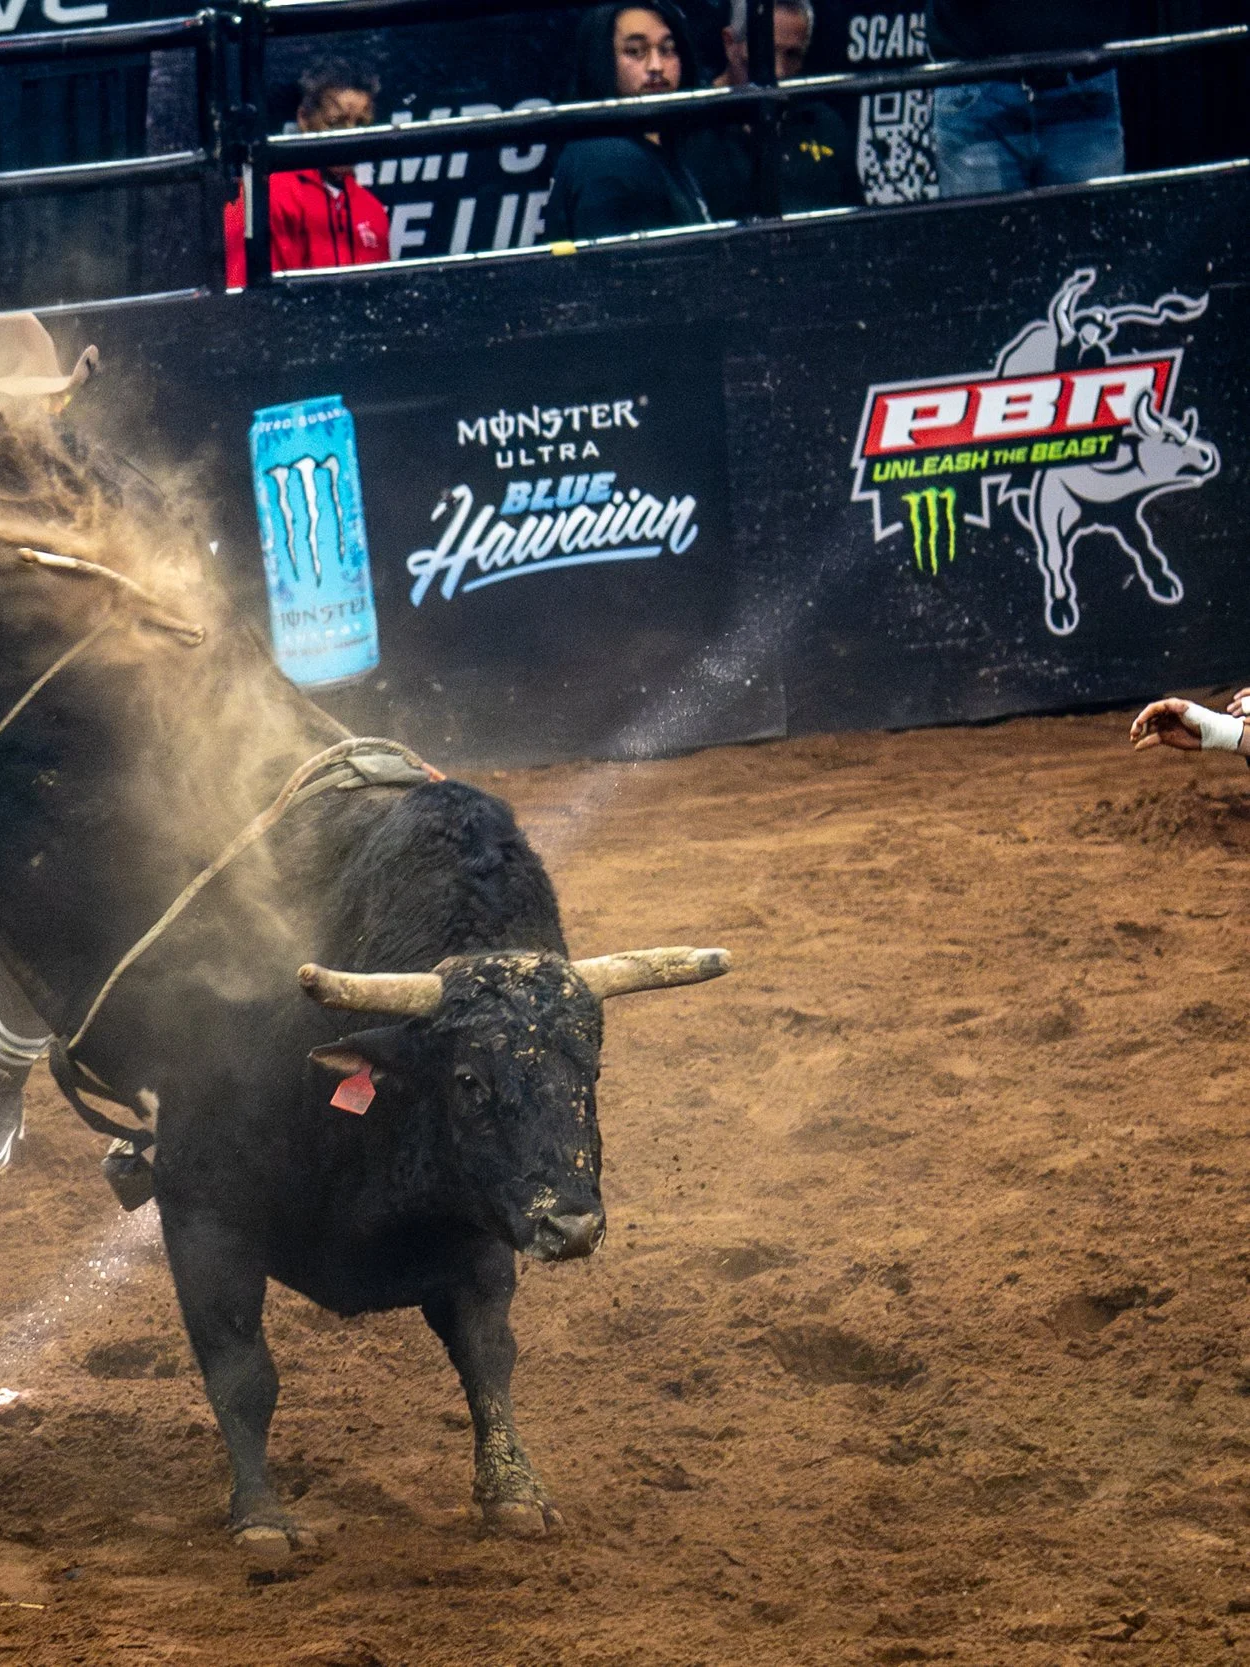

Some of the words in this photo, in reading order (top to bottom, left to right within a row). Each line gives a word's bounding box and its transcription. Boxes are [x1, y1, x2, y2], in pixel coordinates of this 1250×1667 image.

[879, 366, 1156, 449] PBR
[495, 440, 600, 468] ULTRA
[872, 449, 989, 482] UNLEASH
[992, 447, 1027, 464] THE
[1029, 434, 1114, 463] BEAST
[500, 471, 617, 516] BLUE
[407, 484, 698, 607] Hawaiian
